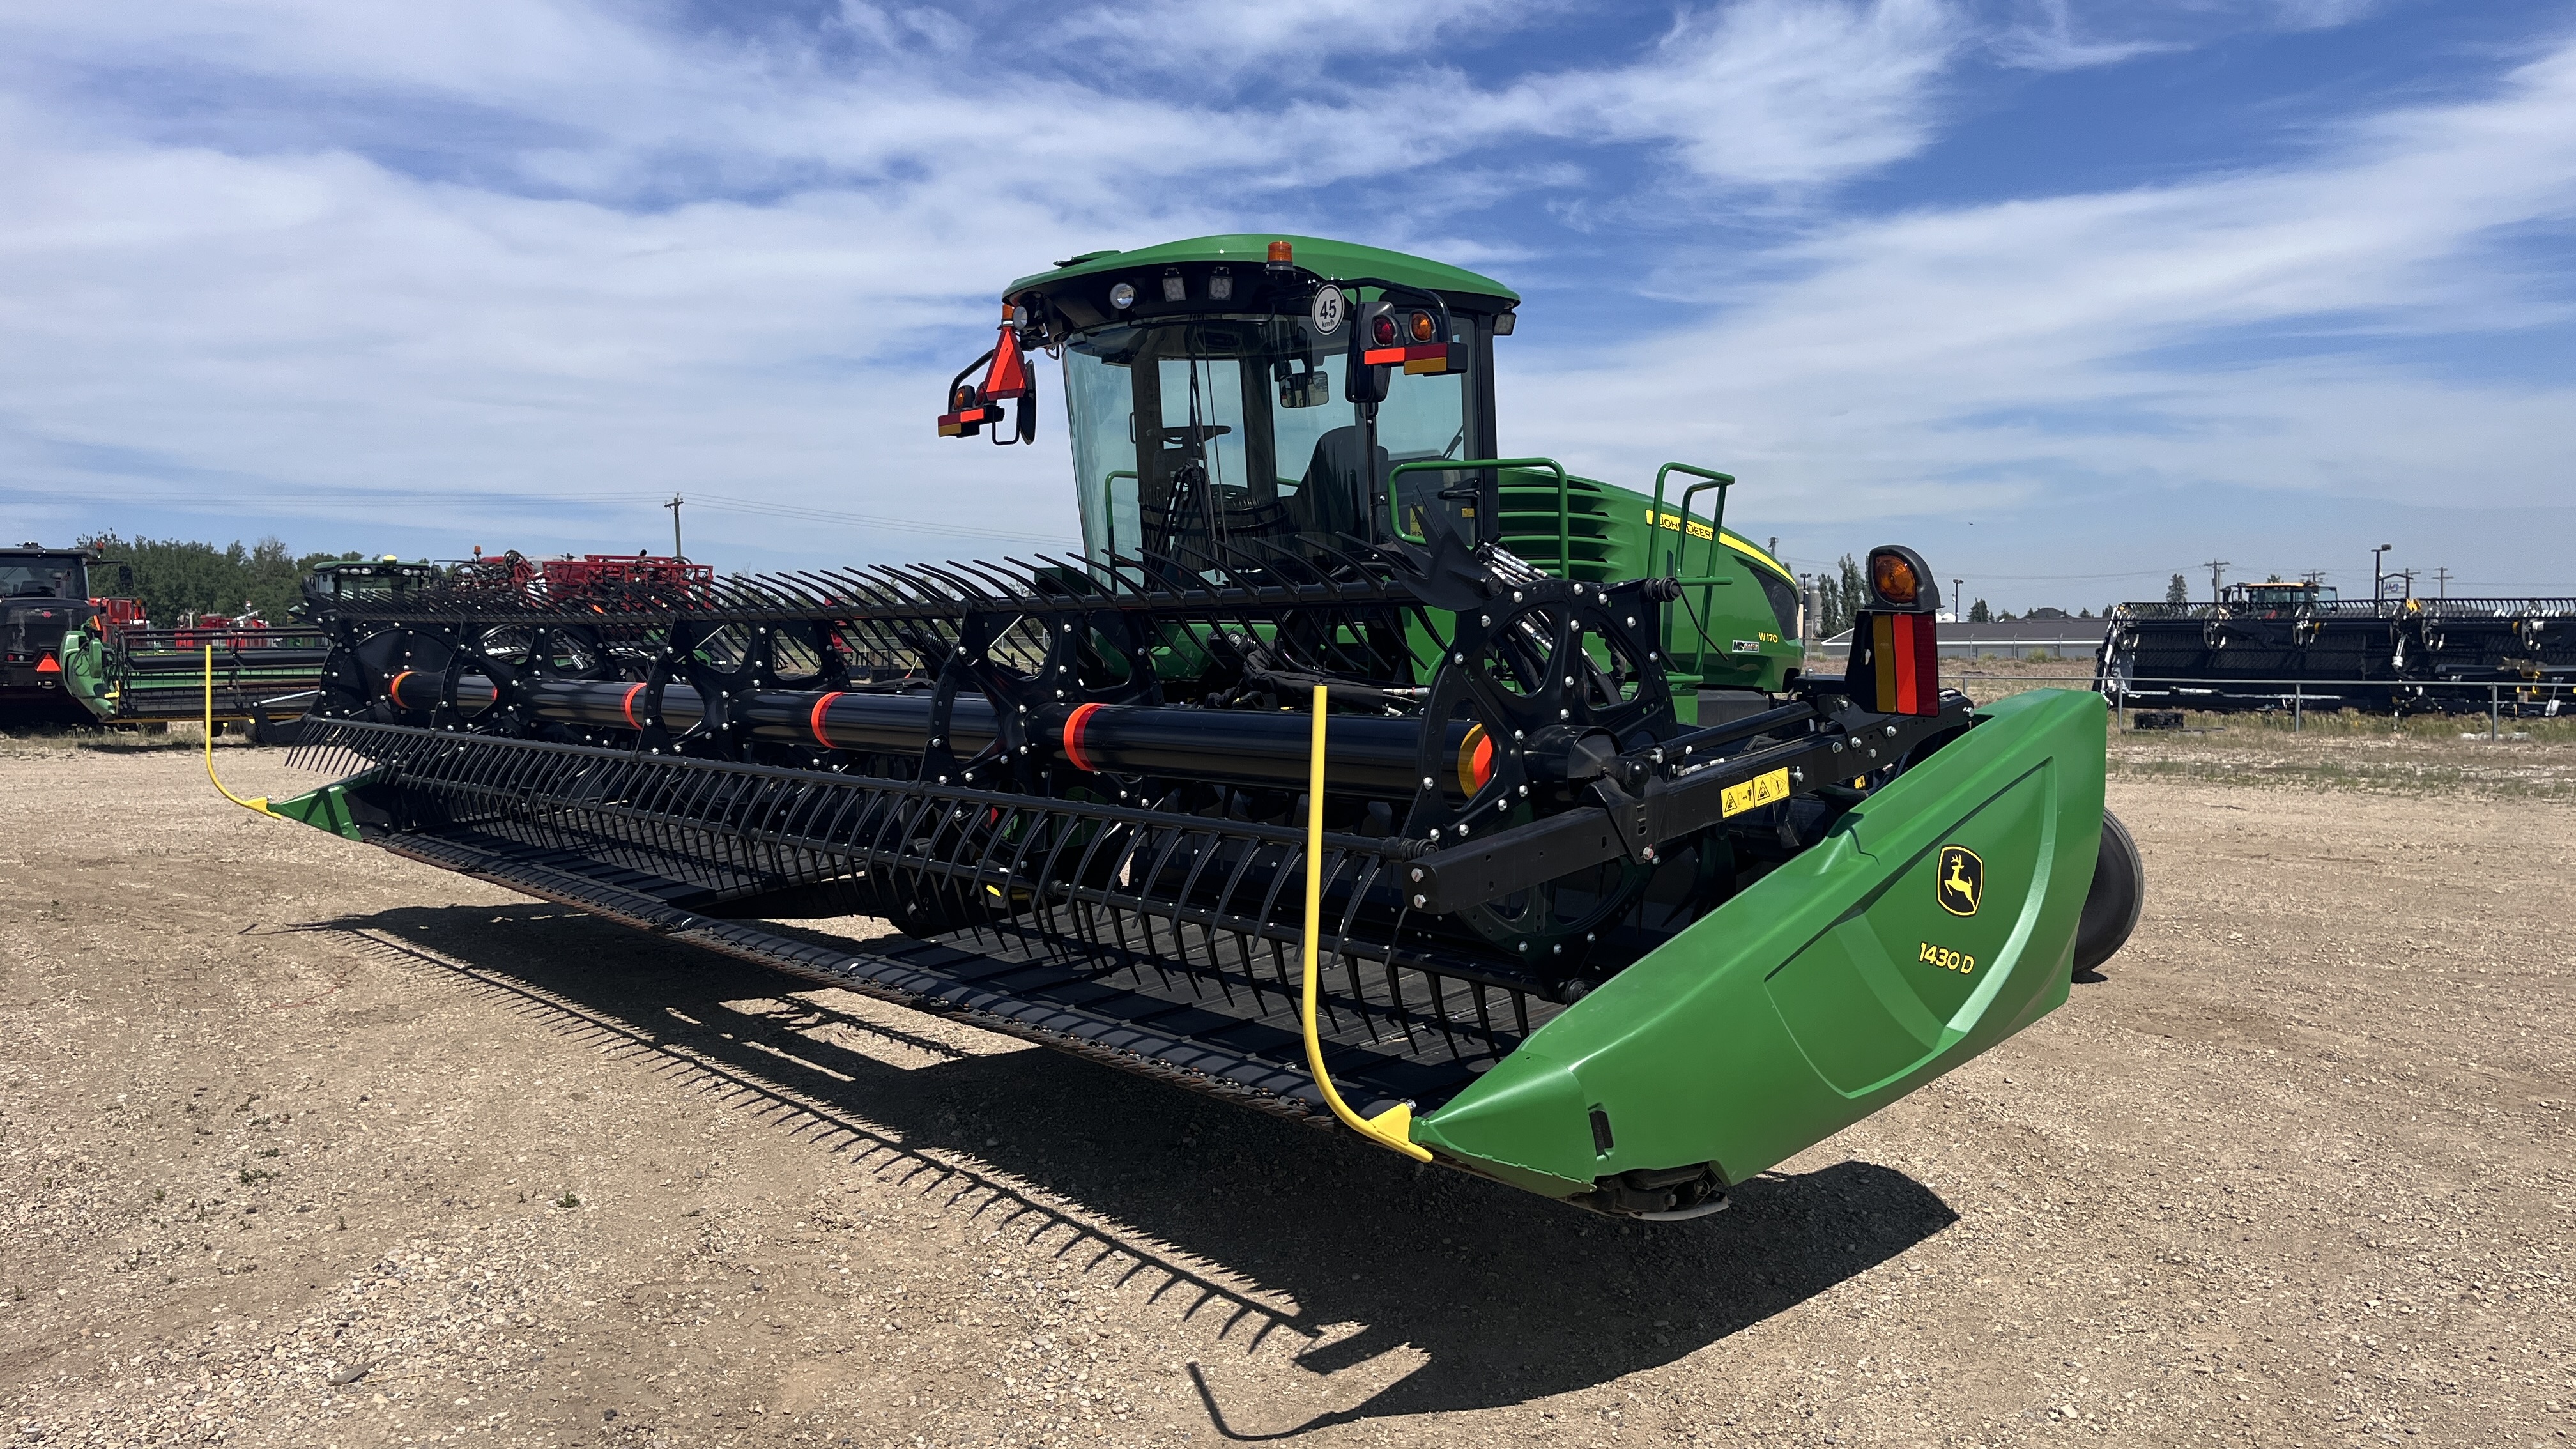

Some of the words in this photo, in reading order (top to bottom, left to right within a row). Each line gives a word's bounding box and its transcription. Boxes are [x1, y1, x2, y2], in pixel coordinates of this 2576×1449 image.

[1319, 298, 1337, 319] 45
[1321, 319, 1335, 328] km/h
[1660, 516, 1680, 530] JOH
[1687, 523, 1713, 539] DEER
[1758, 632, 1766, 641] W
[1766, 632, 1778, 643] 170
[1919, 941, 1961, 970] 1430
[1960, 954, 1975, 974] D
